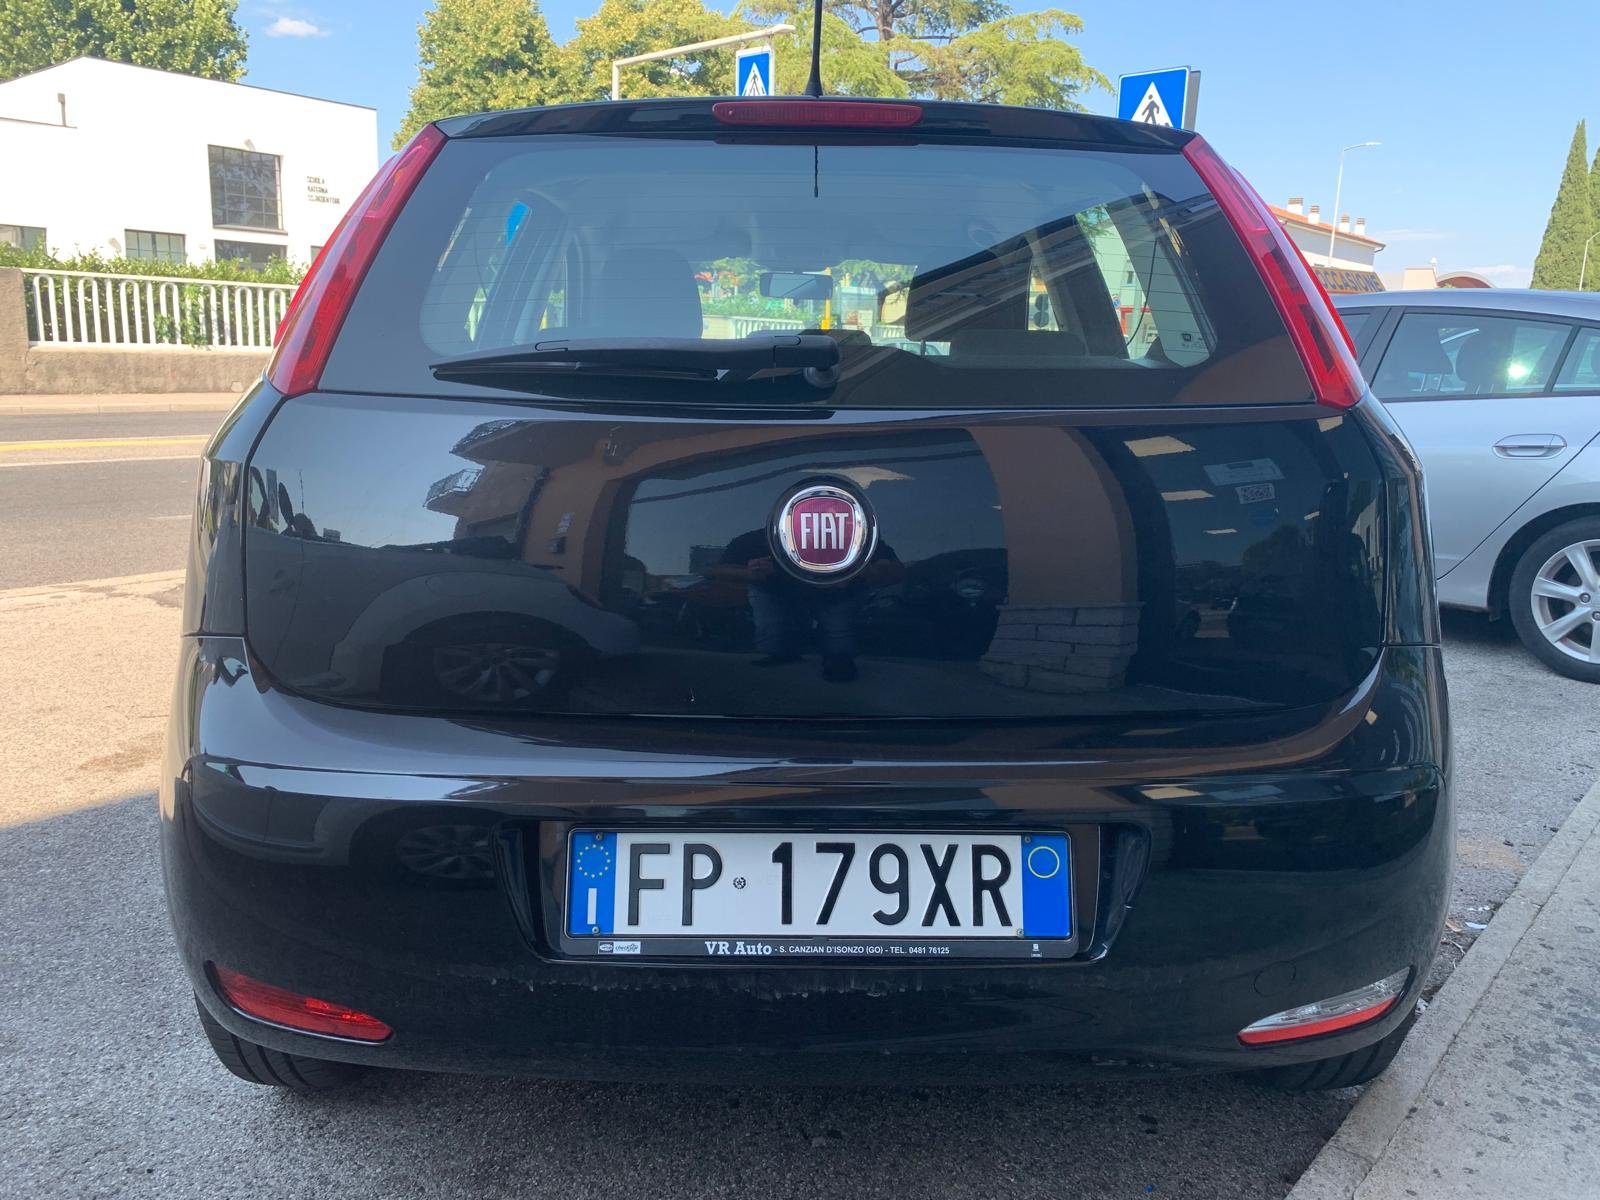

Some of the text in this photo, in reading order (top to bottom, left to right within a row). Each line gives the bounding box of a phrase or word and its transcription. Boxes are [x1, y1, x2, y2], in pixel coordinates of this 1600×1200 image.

[800, 512, 849, 550] FIAT
[627, 842, 1013, 927] FP 179XR
[586, 888, 597, 925] I
[704, 941, 731, 955] VR
[734, 941, 772, 955] Auto
[779, 945, 787, 953] S.
[788, 945, 825, 953] CANZIAN
[826, 945, 865, 954] D'ISONZO
[866, 945, 884, 955] (GO)
[889, 946, 908, 954] TEL.
[908, 946, 926, 954] 0481
[928, 946, 950, 954] 76125
